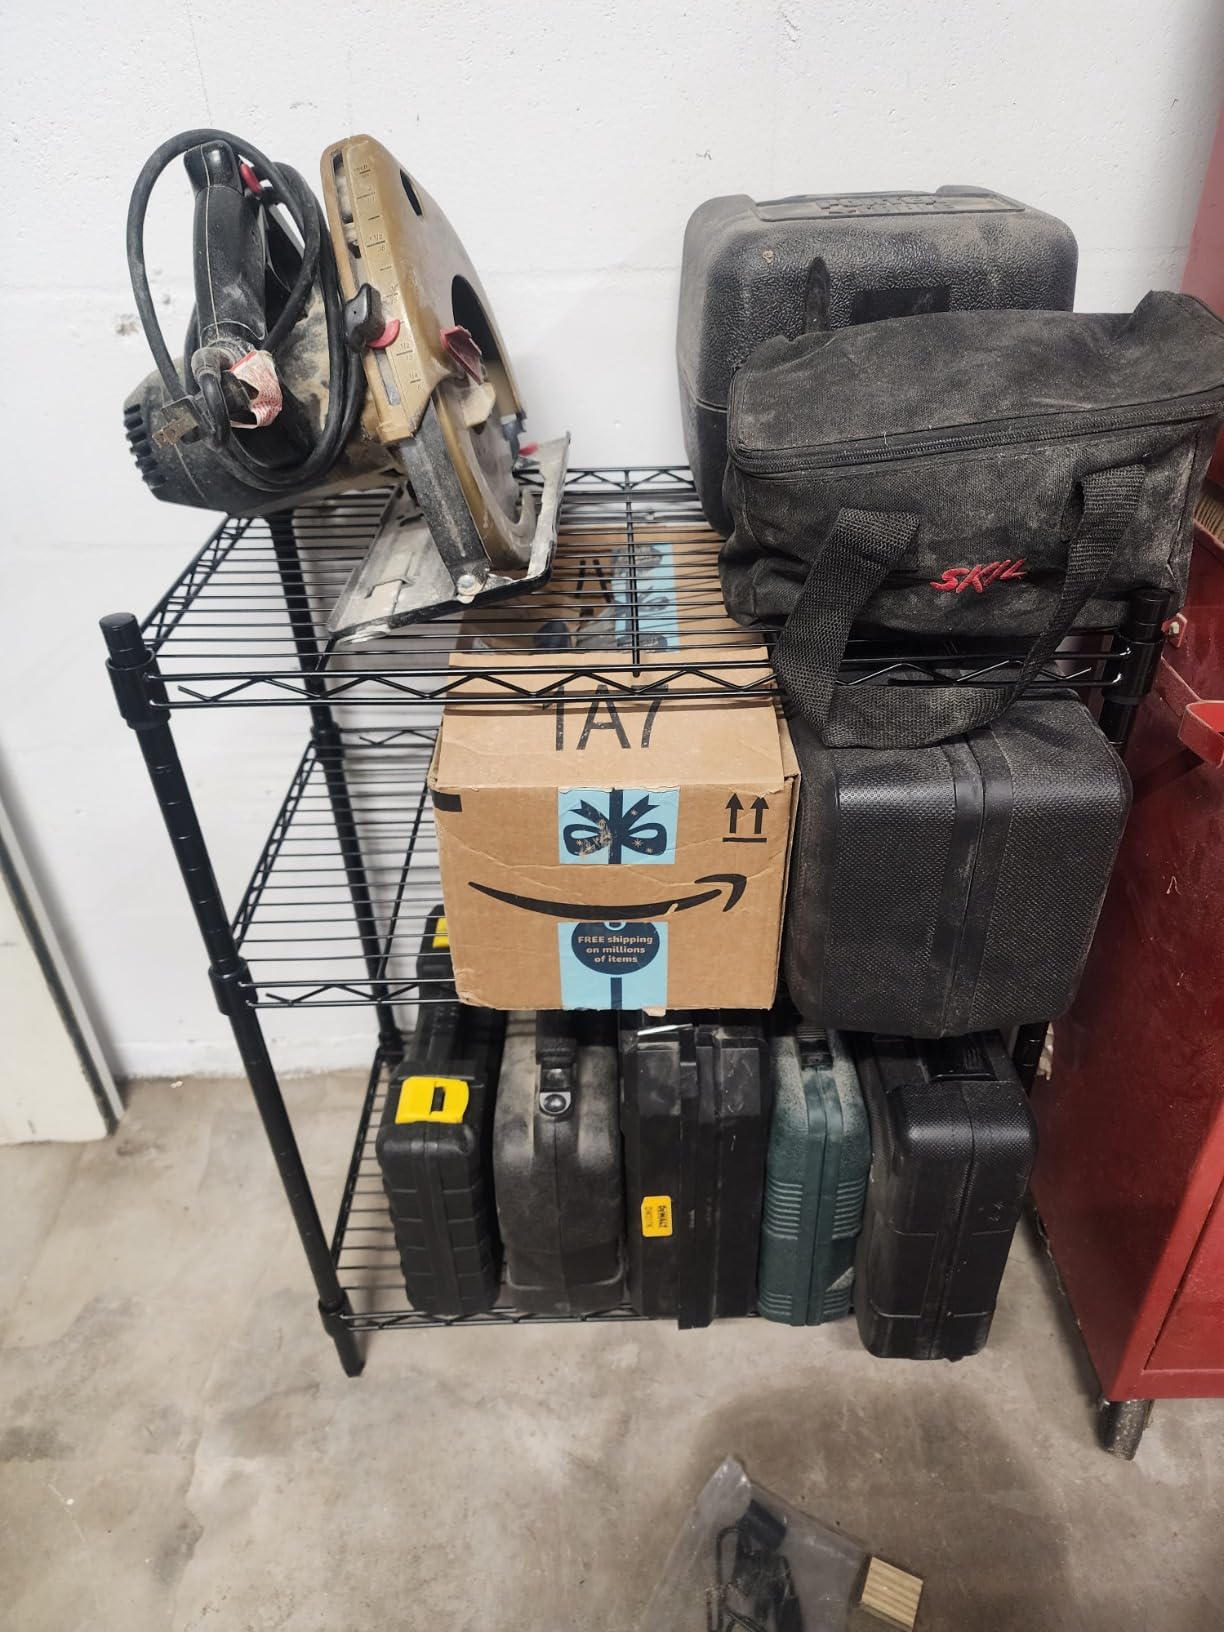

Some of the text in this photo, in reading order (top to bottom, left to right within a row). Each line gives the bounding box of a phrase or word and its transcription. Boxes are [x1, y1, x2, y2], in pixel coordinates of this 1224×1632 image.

[930, 559, 1027, 593] SKIL
[607, 935, 653, 945] shipping
[602, 945, 646, 954] millions
[594, 955, 638, 963] of items
